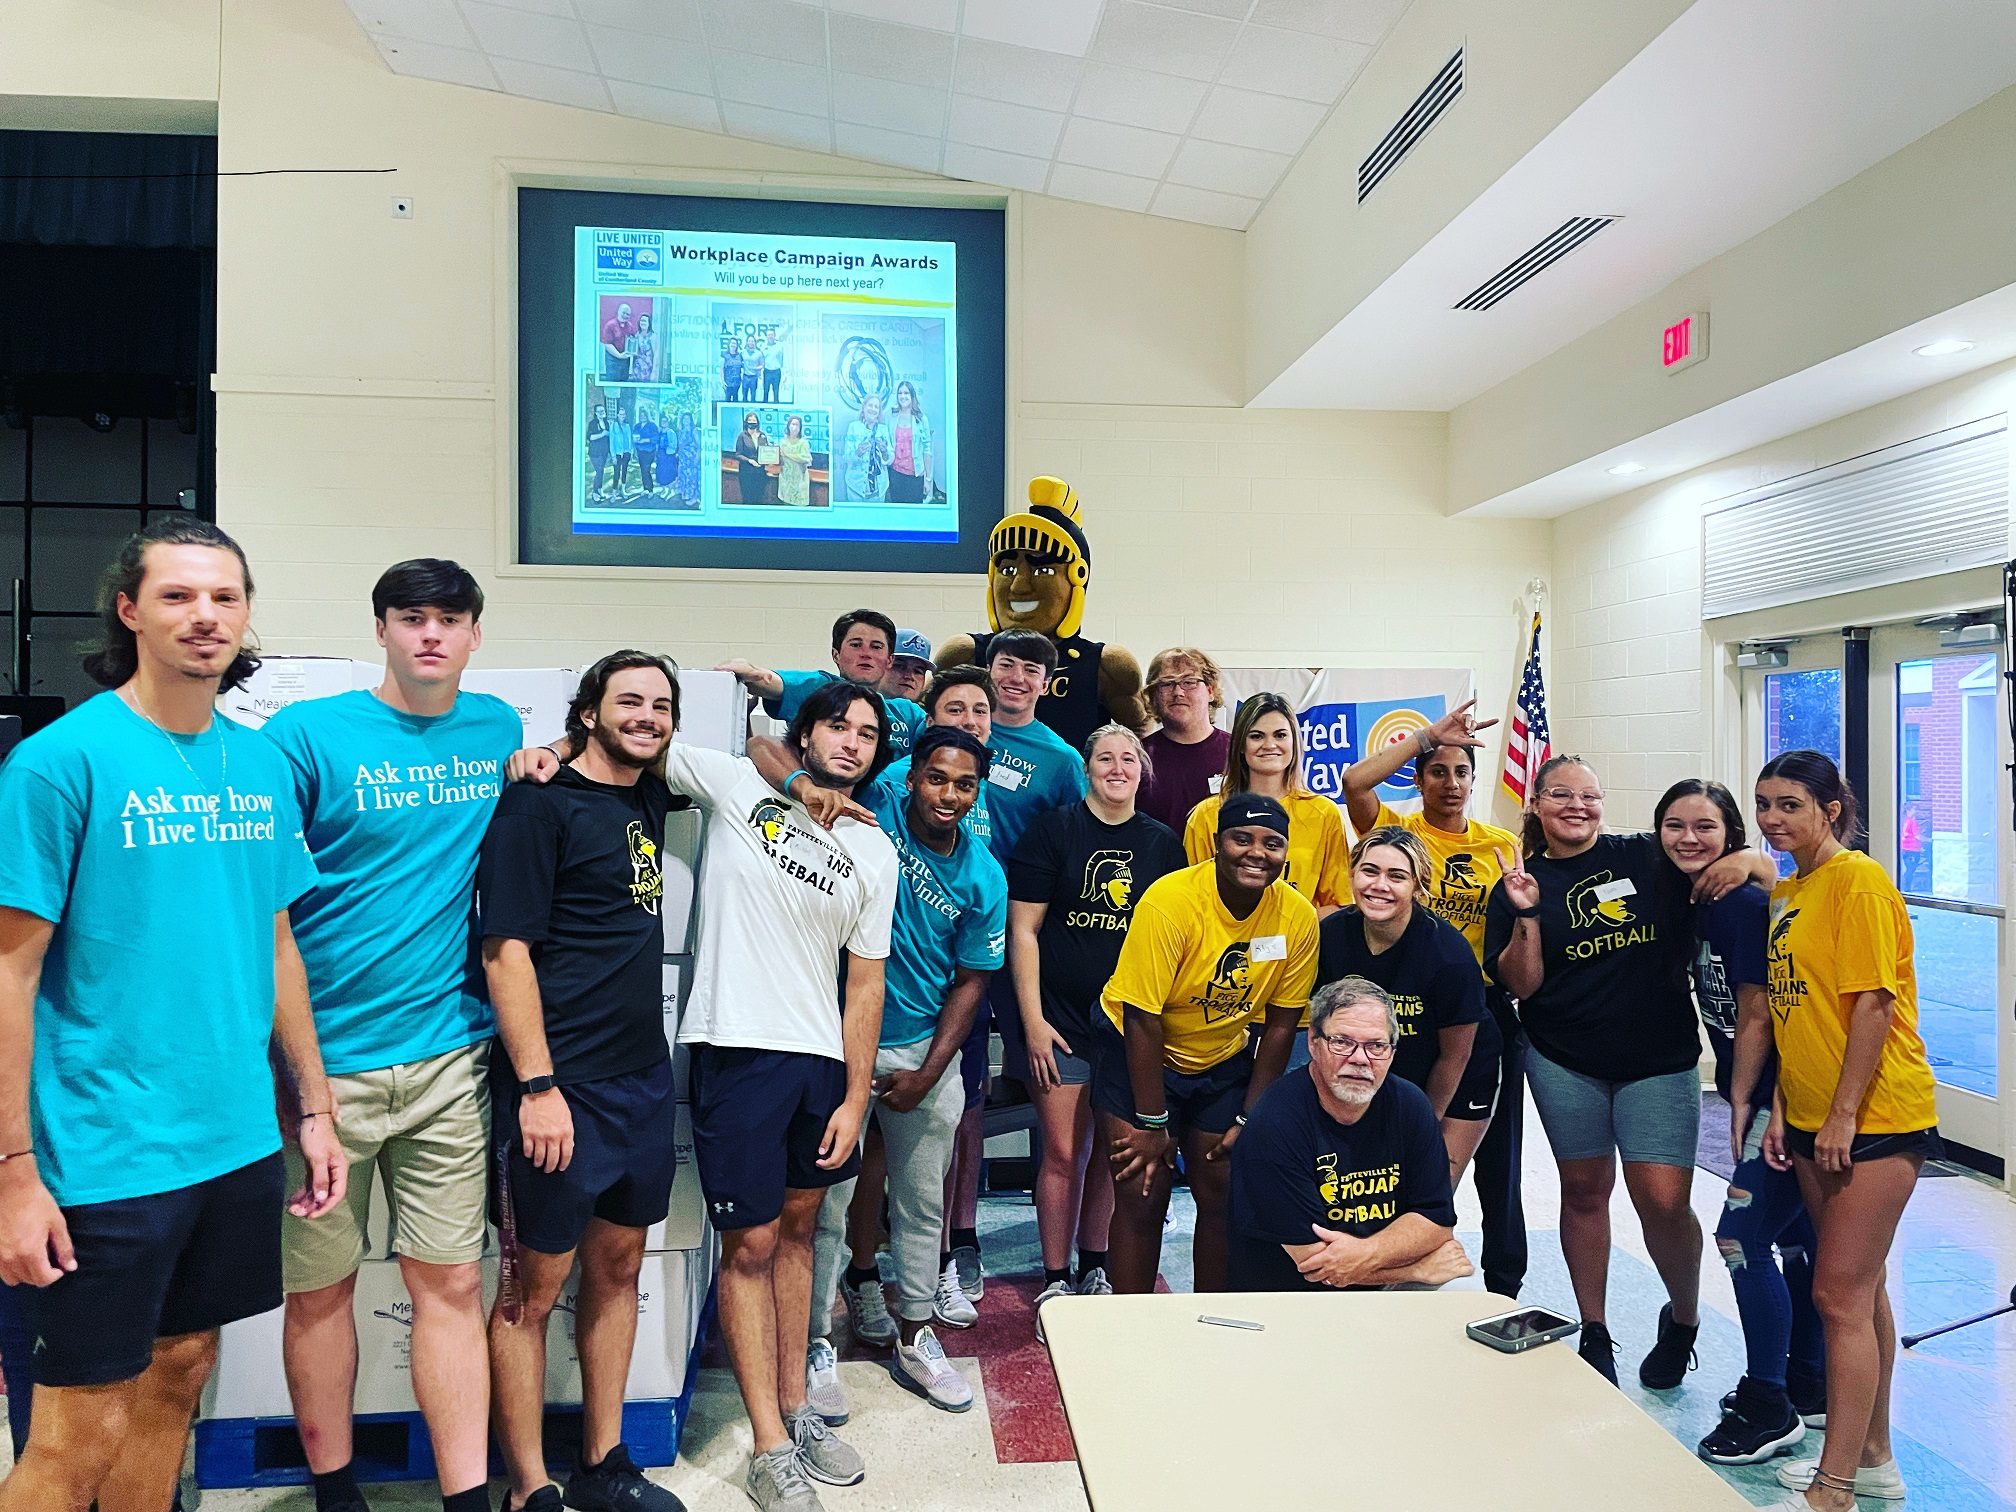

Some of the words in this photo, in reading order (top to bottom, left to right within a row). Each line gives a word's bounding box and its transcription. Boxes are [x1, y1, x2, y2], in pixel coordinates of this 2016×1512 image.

[596, 232, 620, 244] LIVE
[623, 233, 661, 245] UNITED
[599, 247, 633, 258] United
[611, 257, 633, 268] Way
[670, 245, 768, 265] Workplace
[774, 249, 865, 270] Campaign
[870, 253, 939, 270] Awards
[714, 271, 735, 283] Will
[738, 275, 761, 286] you
[762, 273, 776, 285] be
[780, 276, 794, 288] up
[797, 275, 822, 287] here
[825, 277, 850, 288] next
[853, 278, 884, 291] year?
[733, 322, 780, 338] FORT
[1663, 316, 1691, 368] EXIT
[513, 706, 533, 716] ope
[1300, 713, 1351, 752] ted
[353, 761, 402, 786] Ask
[406, 763, 447, 783] me
[452, 755, 498, 778] how
[1001, 748, 1037, 775] how
[1302, 756, 1351, 799] ay
[120, 786, 179, 817] Ask
[181, 794, 221, 813] me
[226, 785, 273, 813] how
[354, 788, 368, 811] I
[373, 786, 421, 810] live
[425, 775, 501, 805] United
[121, 820, 137, 848] I
[145, 816, 196, 846] live
[202, 814, 275, 842] United
[787, 823, 839, 855] FAYETTEVILLE
[762, 840, 835, 896] BASEBALL
[1427, 896, 1487, 917] TROJAN
[1435, 909, 1481, 925] SOFTBALL
[1066, 910, 1128, 932] SOFTBA
[1565, 924, 1657, 961] SOFTBALL
[1189, 996, 1253, 1013] TROJANS
